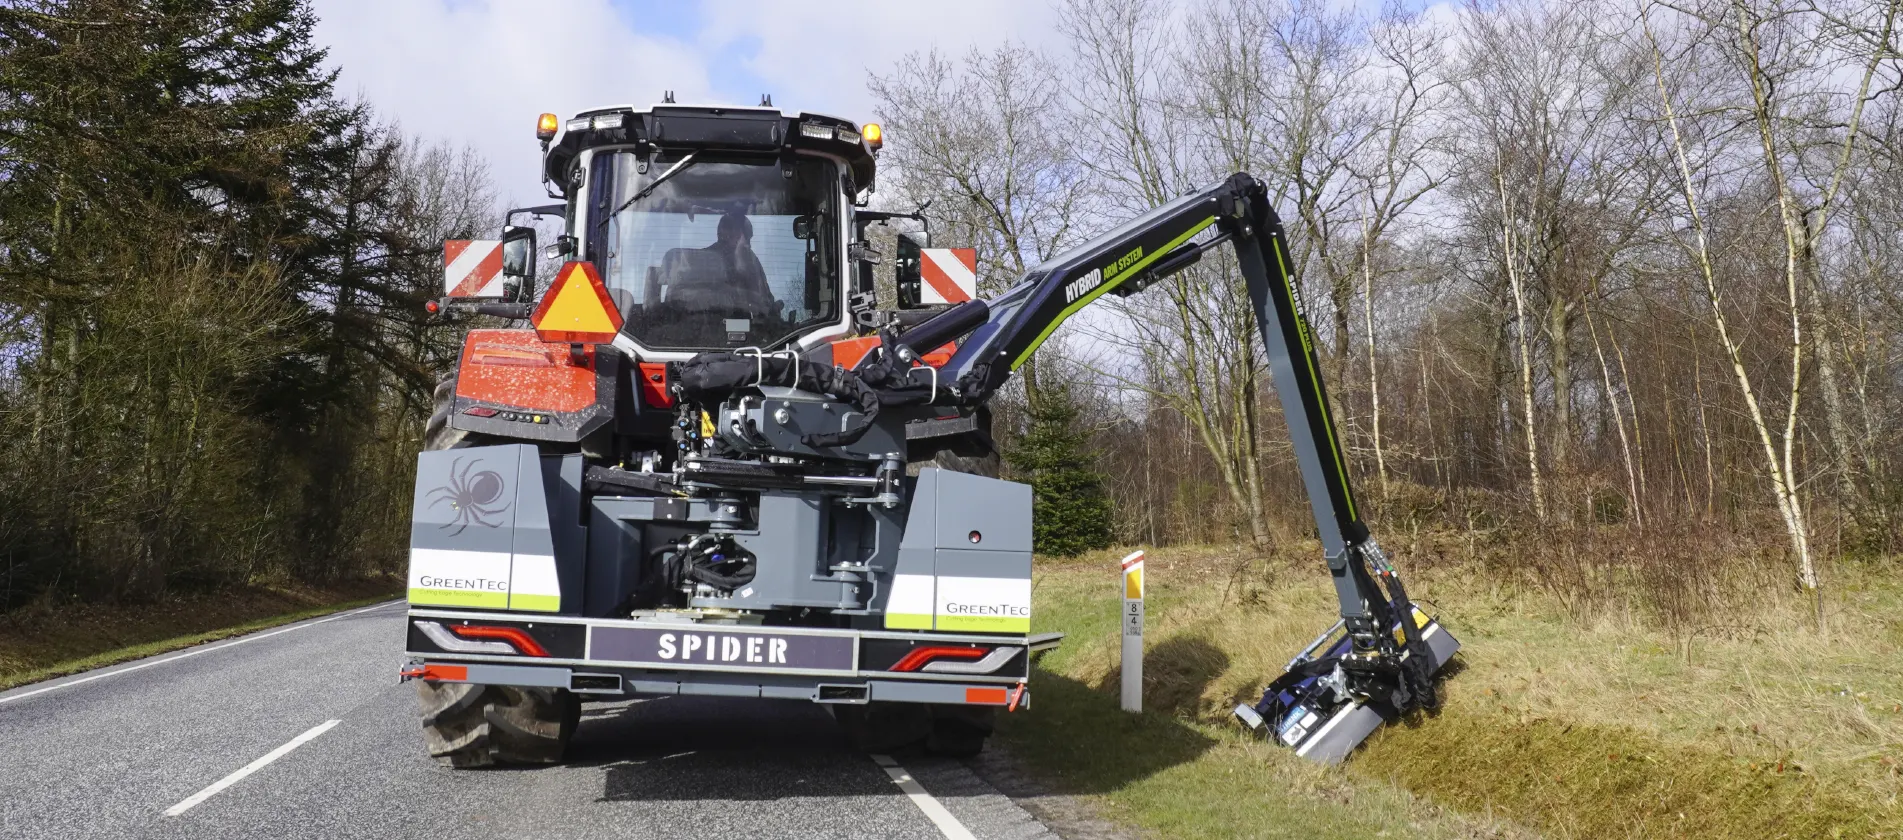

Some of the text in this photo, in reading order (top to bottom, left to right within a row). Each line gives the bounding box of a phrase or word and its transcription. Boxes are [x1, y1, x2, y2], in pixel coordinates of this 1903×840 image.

[1065, 245, 1143, 303] HYBRID ARM SYSTEM
[1288, 274, 1304, 315] SPIDER
[1304, 332, 1313, 353] PLUS
[1130, 616, 1138, 625] 4
[1131, 603, 1137, 613] 8
[658, 633, 787, 664] SPIDER
